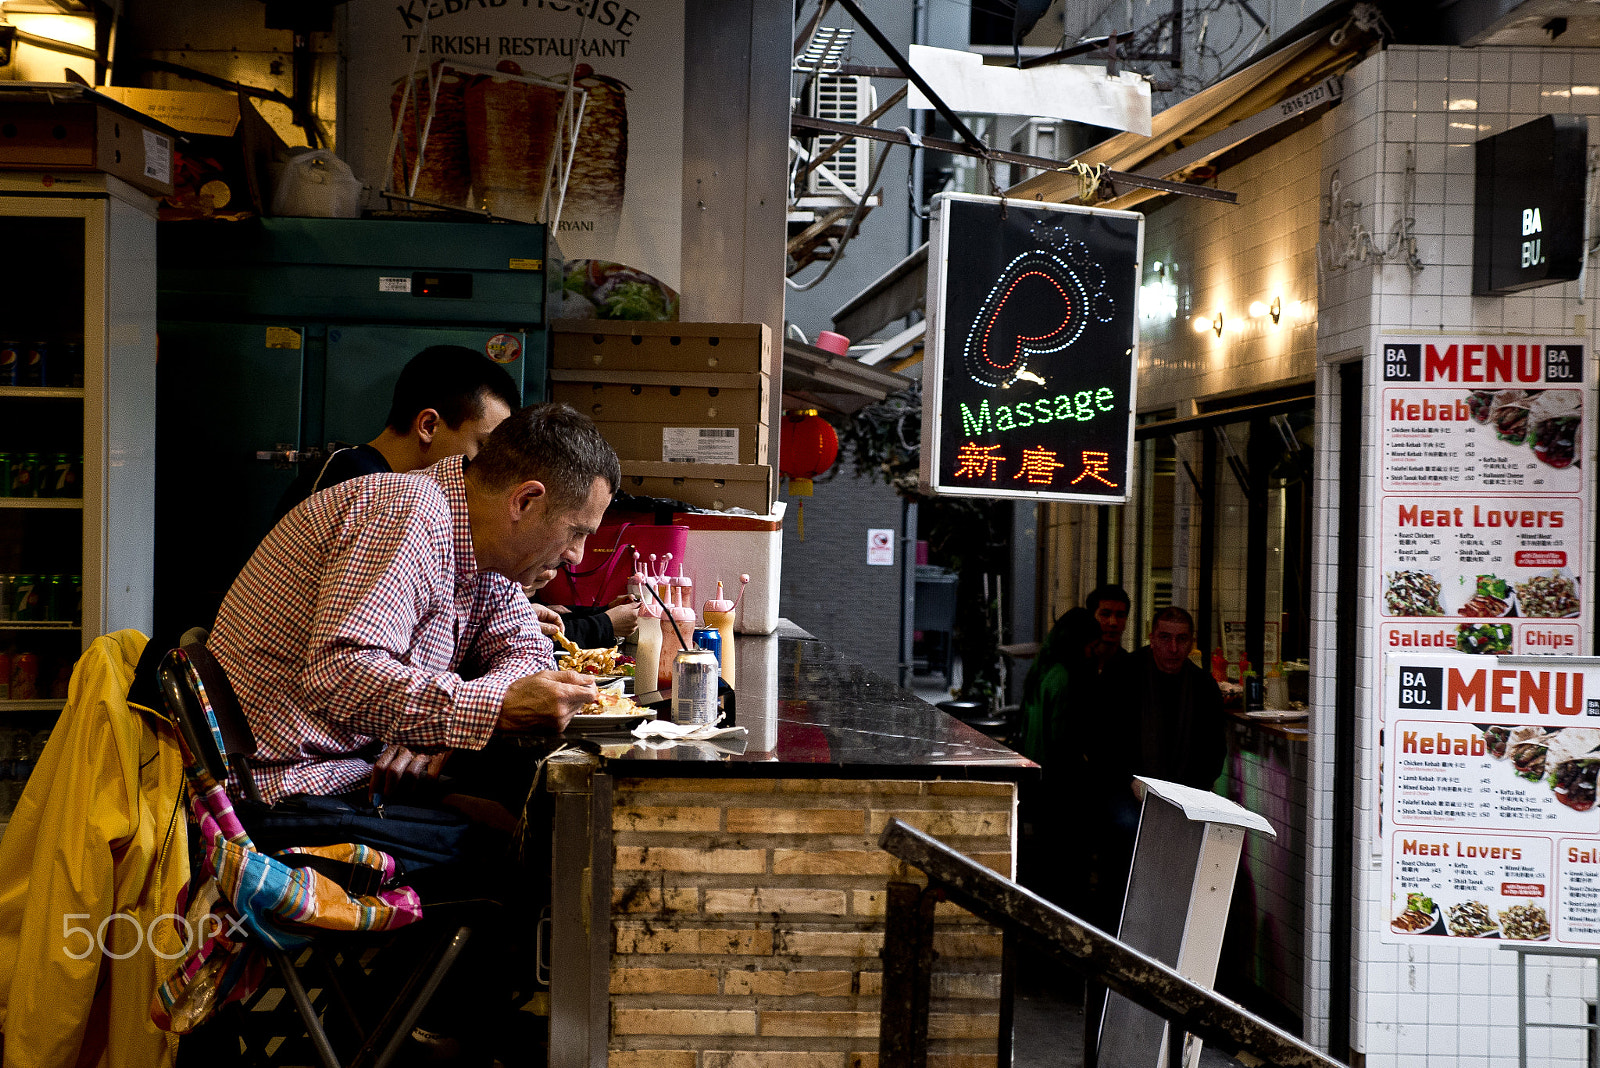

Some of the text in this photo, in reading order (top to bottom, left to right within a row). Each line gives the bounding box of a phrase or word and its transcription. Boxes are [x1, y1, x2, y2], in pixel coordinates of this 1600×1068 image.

[402, 35, 629, 57] TRKISH RESTAURANT
[1281, 87, 1324, 115] 2816 2727
[550, 220, 594, 231] RYANI
[1522, 208, 1542, 236] BA
[1521, 239, 1546, 268] BU.
[1386, 344, 1569, 383] BA MENU BA
[1386, 364, 1573, 380] BU. BU.
[960, 387, 1115, 437] Massage
[1390, 399, 1470, 422] Kebab
[954, 441, 1118, 488] 新唐足
[1398, 504, 1564, 528] Meat Lovers
[1389, 630, 1574, 649] Salads Chips
[1402, 668, 1584, 716] BA MENU
[1402, 690, 1431, 705] BU.
[1403, 731, 1486, 757] Kebab
[1403, 839, 1522, 860] Meat Lovers
[1568, 847, 1600, 864] Sal
